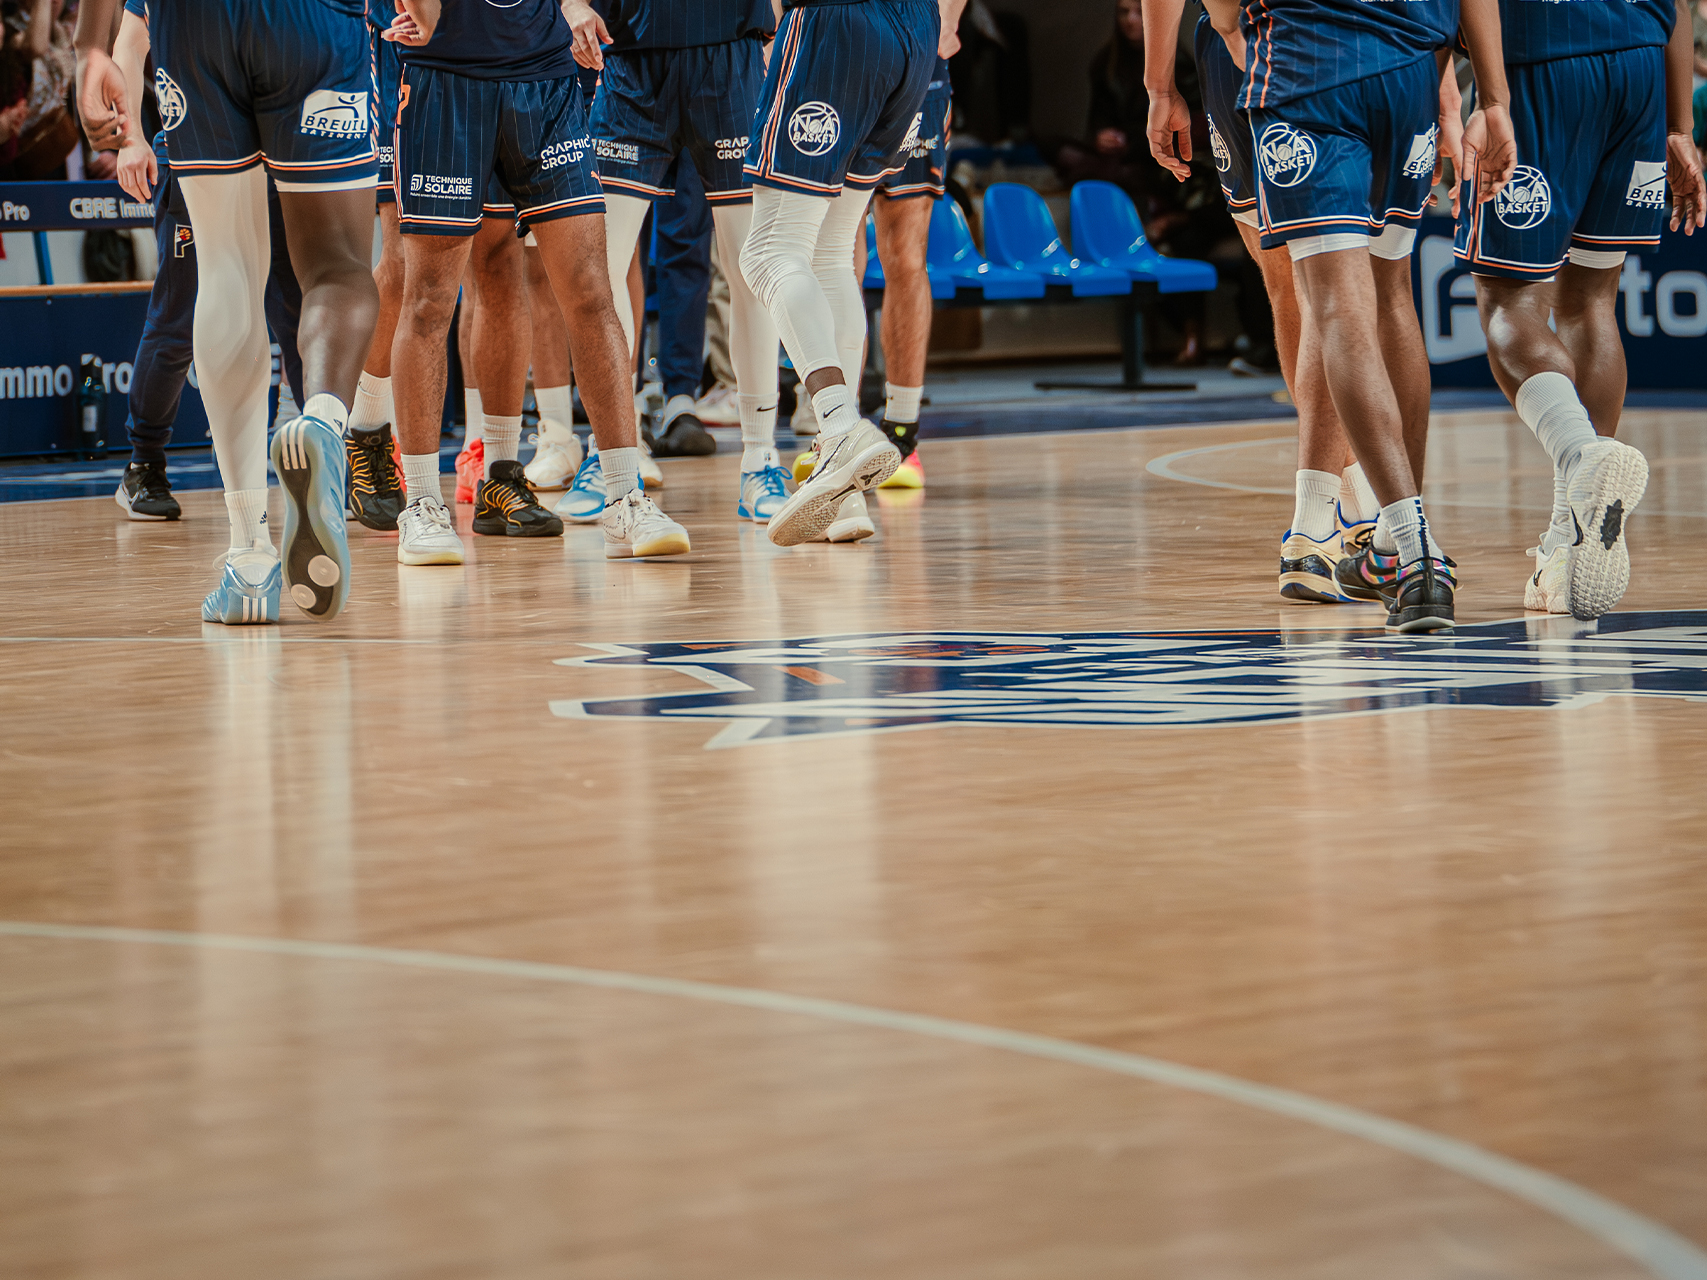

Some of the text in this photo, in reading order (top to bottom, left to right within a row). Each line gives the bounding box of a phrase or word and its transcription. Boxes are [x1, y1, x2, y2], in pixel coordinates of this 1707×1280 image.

[304, 115, 367, 131] BREUIL
[714, 135, 750, 149] GRAP
[793, 131, 836, 144] BASKET
[596, 146, 639, 162] SOLAIRE
[598, 138, 639, 154] TECHNIQUE
[541, 150, 584, 170] GROUP
[1267, 154, 1313, 178] BASKET
[425, 175, 473, 185] TECHNIQUE
[424, 182, 473, 195] SOLAIRE
[2, 201, 30, 221] Pro
[70, 197, 119, 219] CBRE
[1498, 201, 1548, 214] BASKET
[0, 364, 73, 400] mmo
